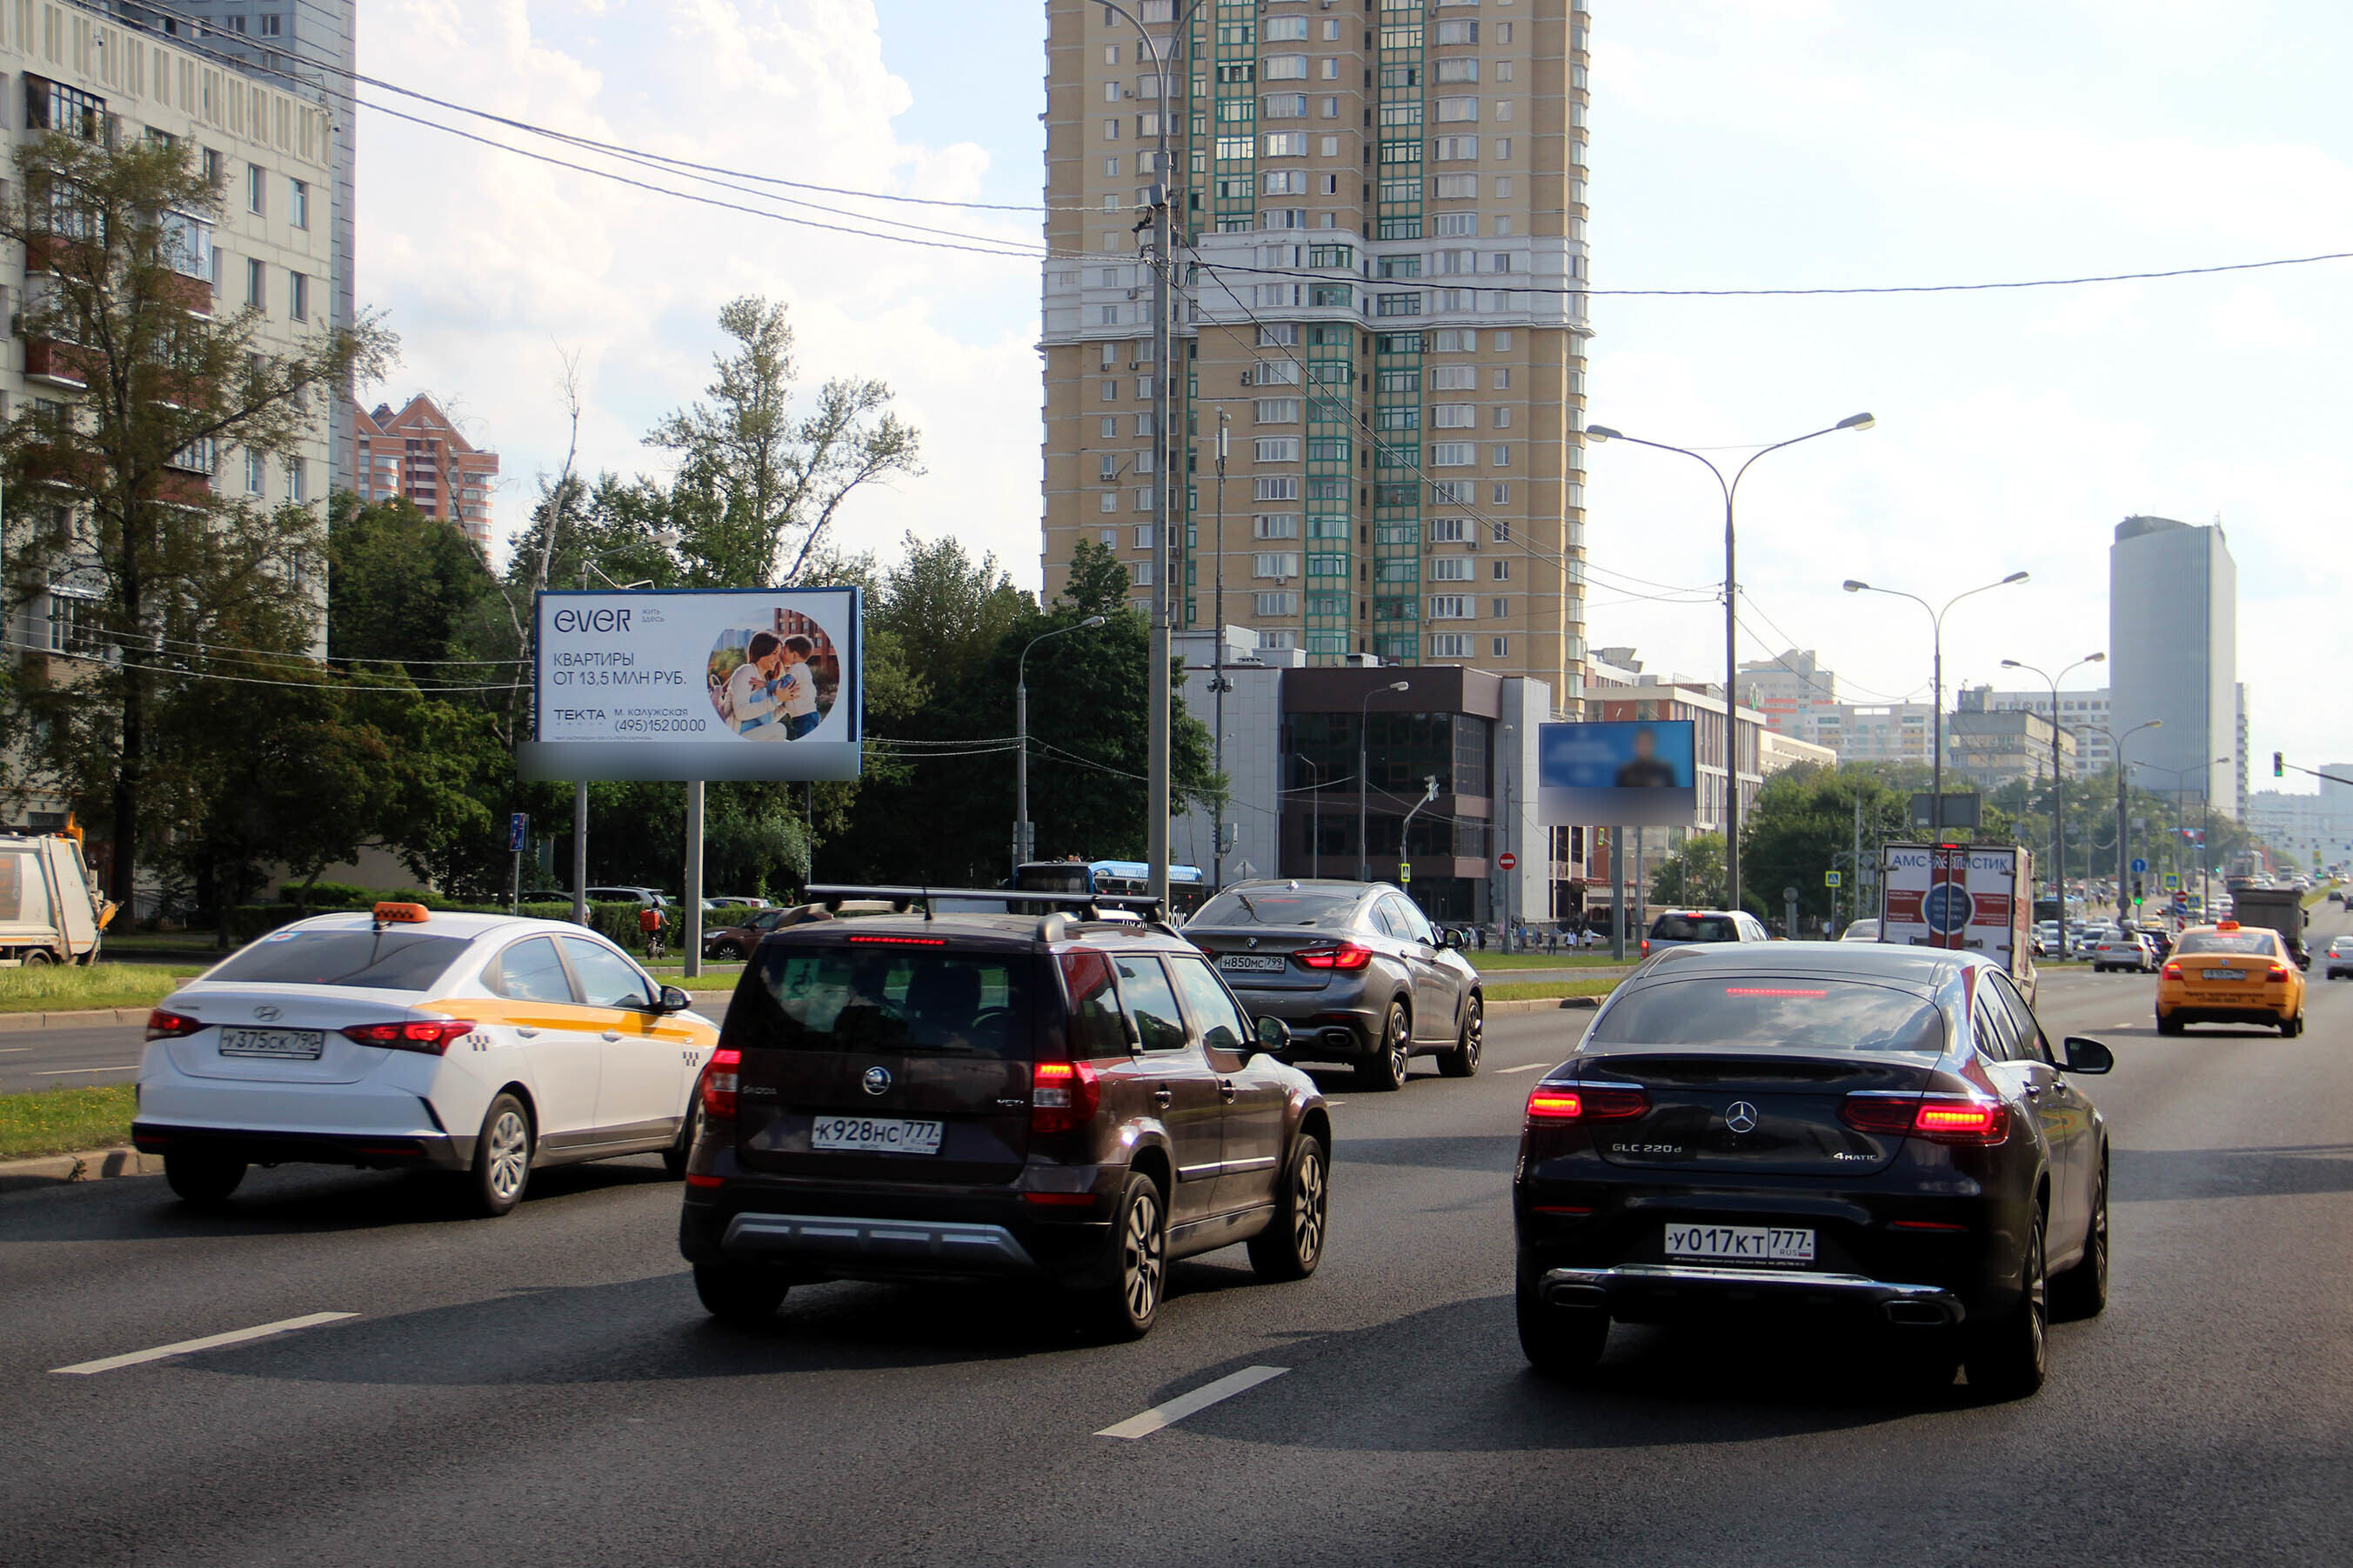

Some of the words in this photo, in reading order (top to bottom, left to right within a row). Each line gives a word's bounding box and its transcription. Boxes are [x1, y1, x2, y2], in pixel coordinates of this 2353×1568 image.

[554, 652, 634, 666] КВАРТИРЫ
[553, 671, 575, 685] ОТ
[579, 671, 609, 686] 13,5
[613, 671, 650, 685] МЛН
[654, 671, 687, 684] РУБ.
[628, 709, 688, 717] калужская
[819, 1119, 900, 1143] К928НС
[905, 1121, 937, 1139] 777
[1612, 1143, 1640, 1152] GLC
[1833, 1151, 1877, 1161] 4MATIC
[1673, 1227, 1765, 1254] У017КТ
[1770, 1229, 1808, 1250] 777
